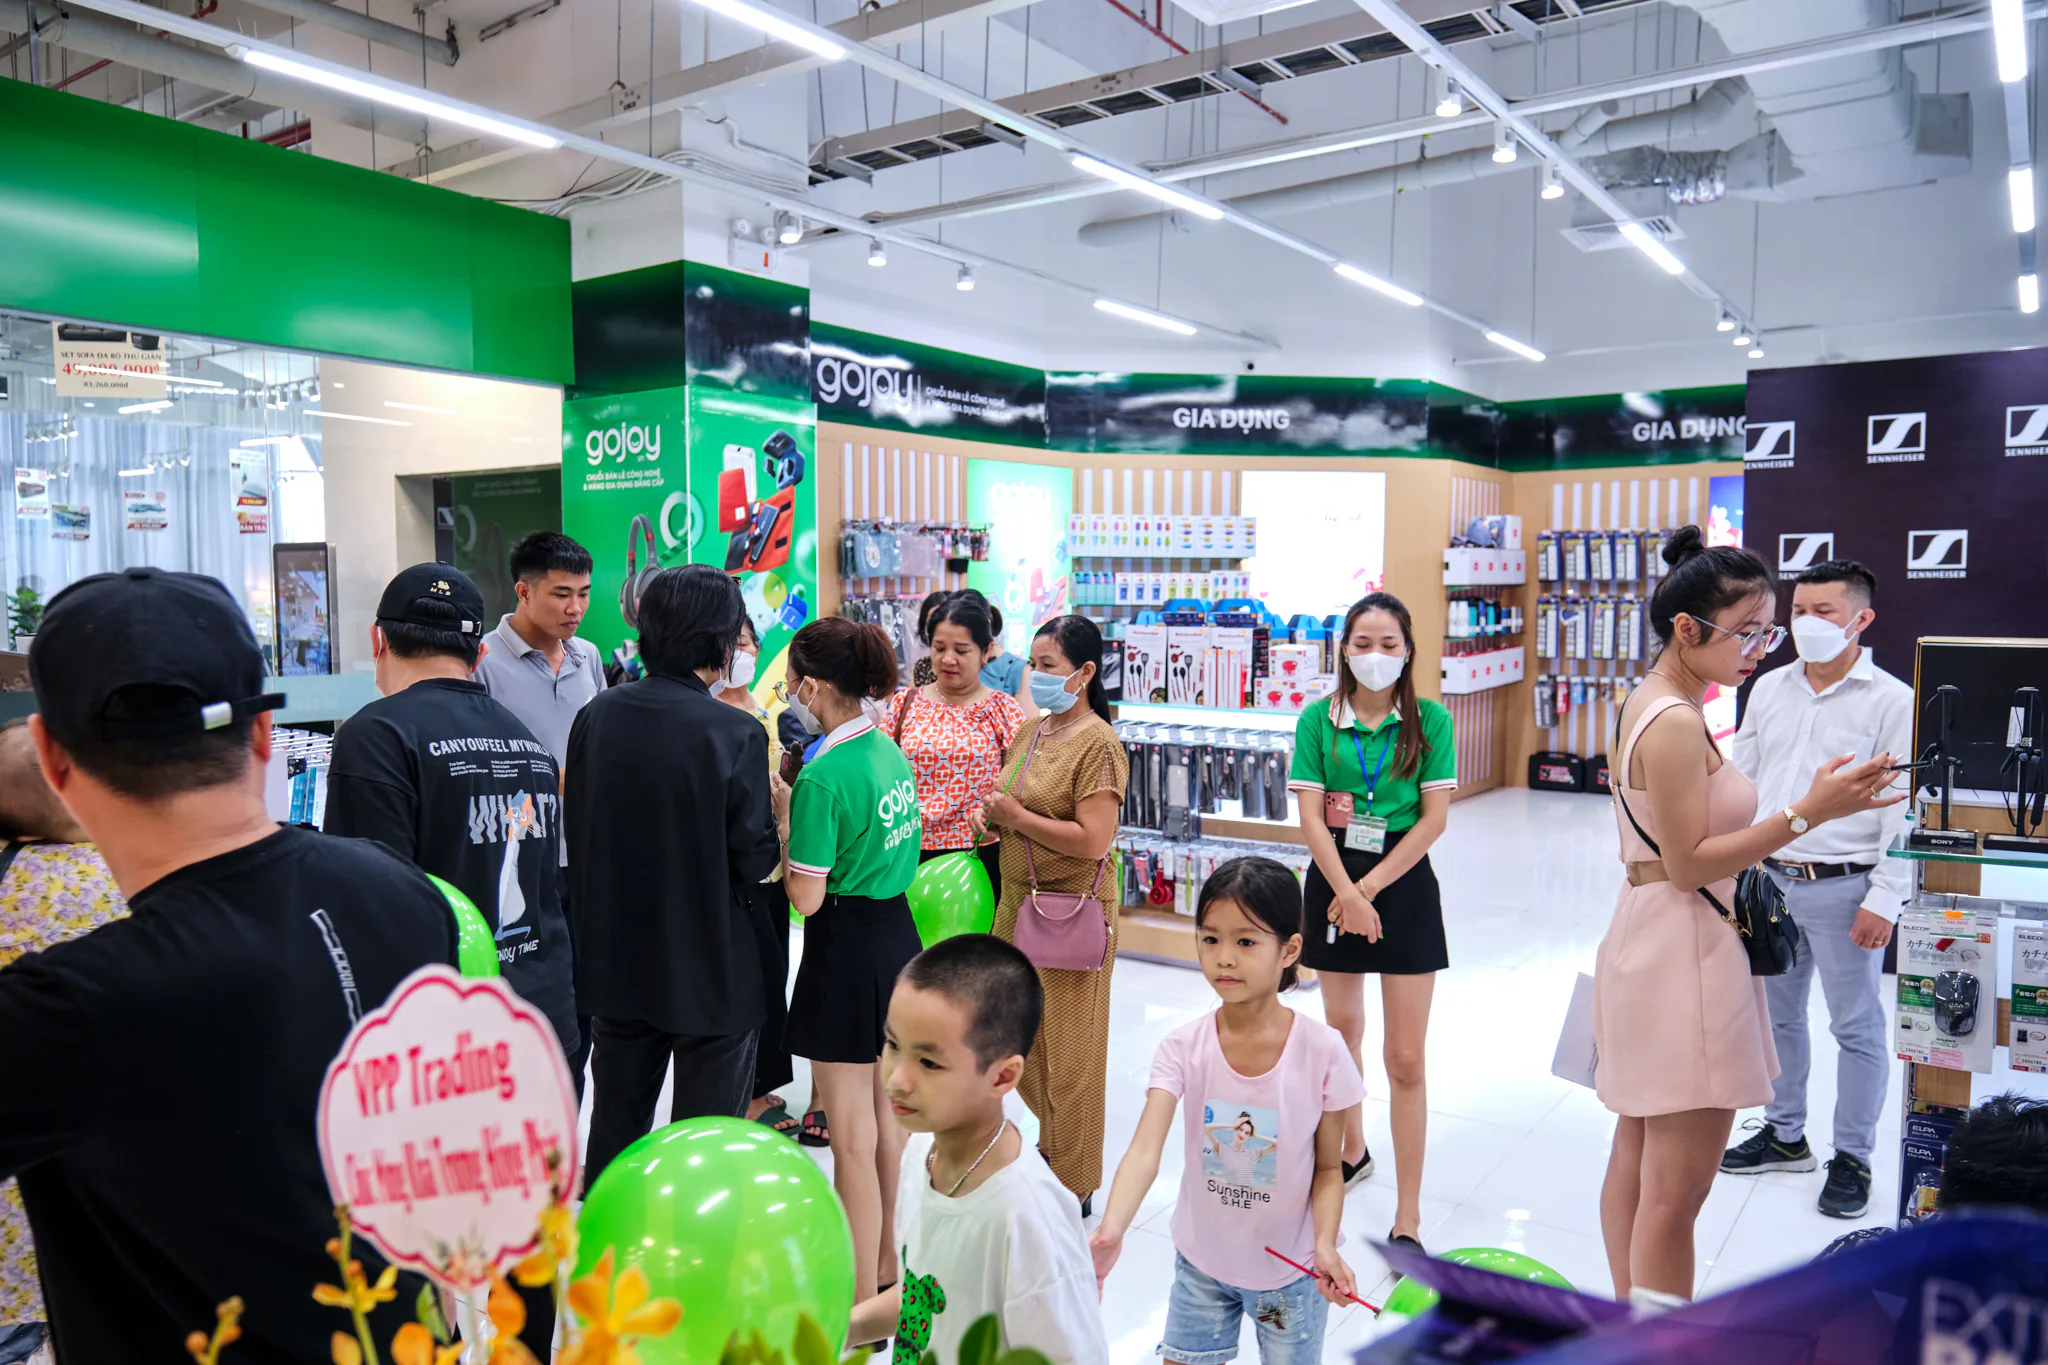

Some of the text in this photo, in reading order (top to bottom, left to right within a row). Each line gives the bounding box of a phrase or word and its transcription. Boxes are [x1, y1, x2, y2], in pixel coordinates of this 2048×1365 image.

[60, 351, 74, 359] SET
[76, 351, 95, 360] SOFA
[815, 357, 914, 415] gojoy
[1172, 407, 1291, 435] GIA DỤNG
[1632, 420, 1677, 442] GIA
[585, 422, 661, 467] gojoy
[1866, 452, 1926, 465] SENNHEISER
[1906, 569, 1967, 580] SENNHEISER
[429, 737, 509, 757] CANYOUFEEL
[877, 778, 917, 829] gojo
[1930, 838, 1955, 846] SONY
[518, 939, 540, 956] TIME
[353, 1031, 517, 1119] VPP Trading
[1912, 1125, 1936, 1134] ELPA
[1907, 1146, 1932, 1157] ELPA
[1207, 1179, 1271, 1203] Sunshine
[1220, 1195, 1252, 1210] S.H.E
